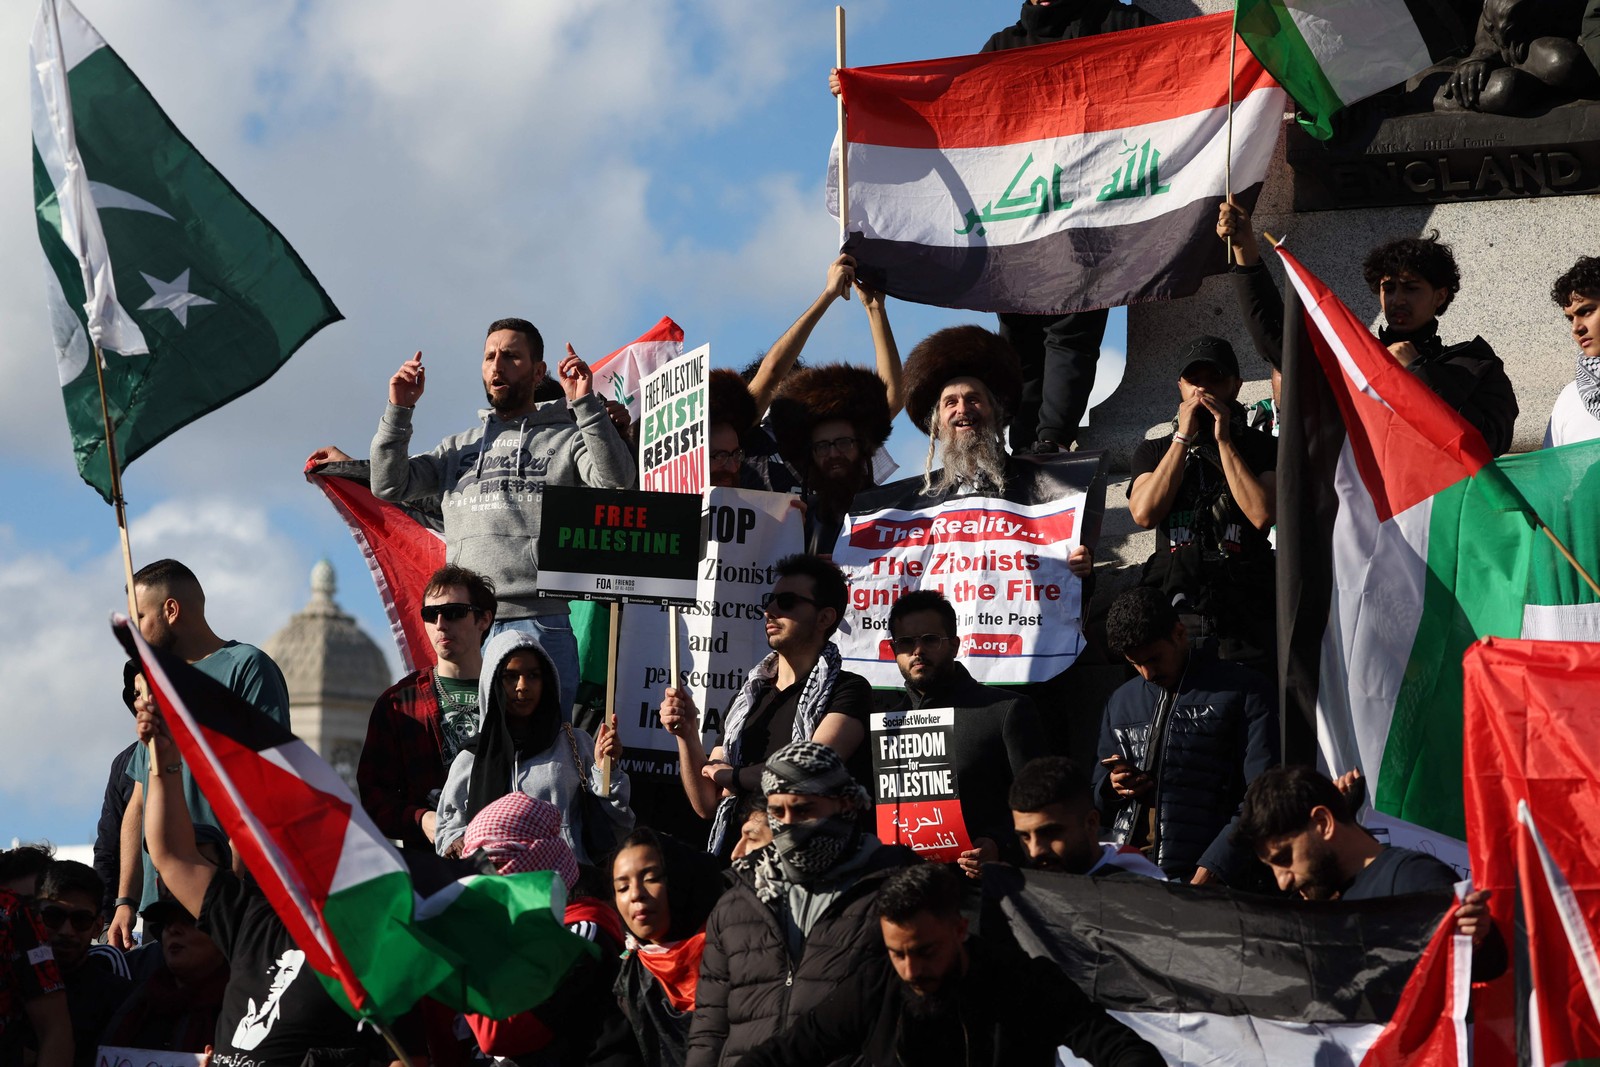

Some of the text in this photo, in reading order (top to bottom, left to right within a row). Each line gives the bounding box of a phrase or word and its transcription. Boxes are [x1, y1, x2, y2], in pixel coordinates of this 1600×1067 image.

[1332, 152, 1582, 199] ENGLAND
[645, 354, 704, 413] FREE PALESTINE
[644, 388, 705, 446] EXIST!
[644, 420, 705, 472] RESIST!
[594, 504, 648, 529] FREE
[708, 505, 756, 544] TOP
[875, 515, 1045, 543] The Reality...
[558, 526, 681, 555] PALESTINE
[704, 558, 775, 584] Zionist
[869, 549, 1041, 577] The Zionists
[596, 578, 612, 590] FOA
[615, 579, 635, 588] FRIENDS
[954, 582, 996, 603] the
[1007, 580, 1061, 601] Fire
[660, 598, 764, 621] assacres
[862, 617, 890, 631] Bot
[977, 612, 1003, 625] the
[1008, 613, 1043, 626] Past
[688, 631, 729, 653] and
[643, 666, 748, 690] pesecuti
[464, 694, 479, 704] IR
[882, 713, 941, 728] Socialist Worker
[879, 732, 946, 760] FREEDOM
[908, 759, 919, 771] for
[879, 770, 954, 798] PALESTINE
[892, 807, 944, 833] الحرية
[891, 831, 959, 851] لفلسط
